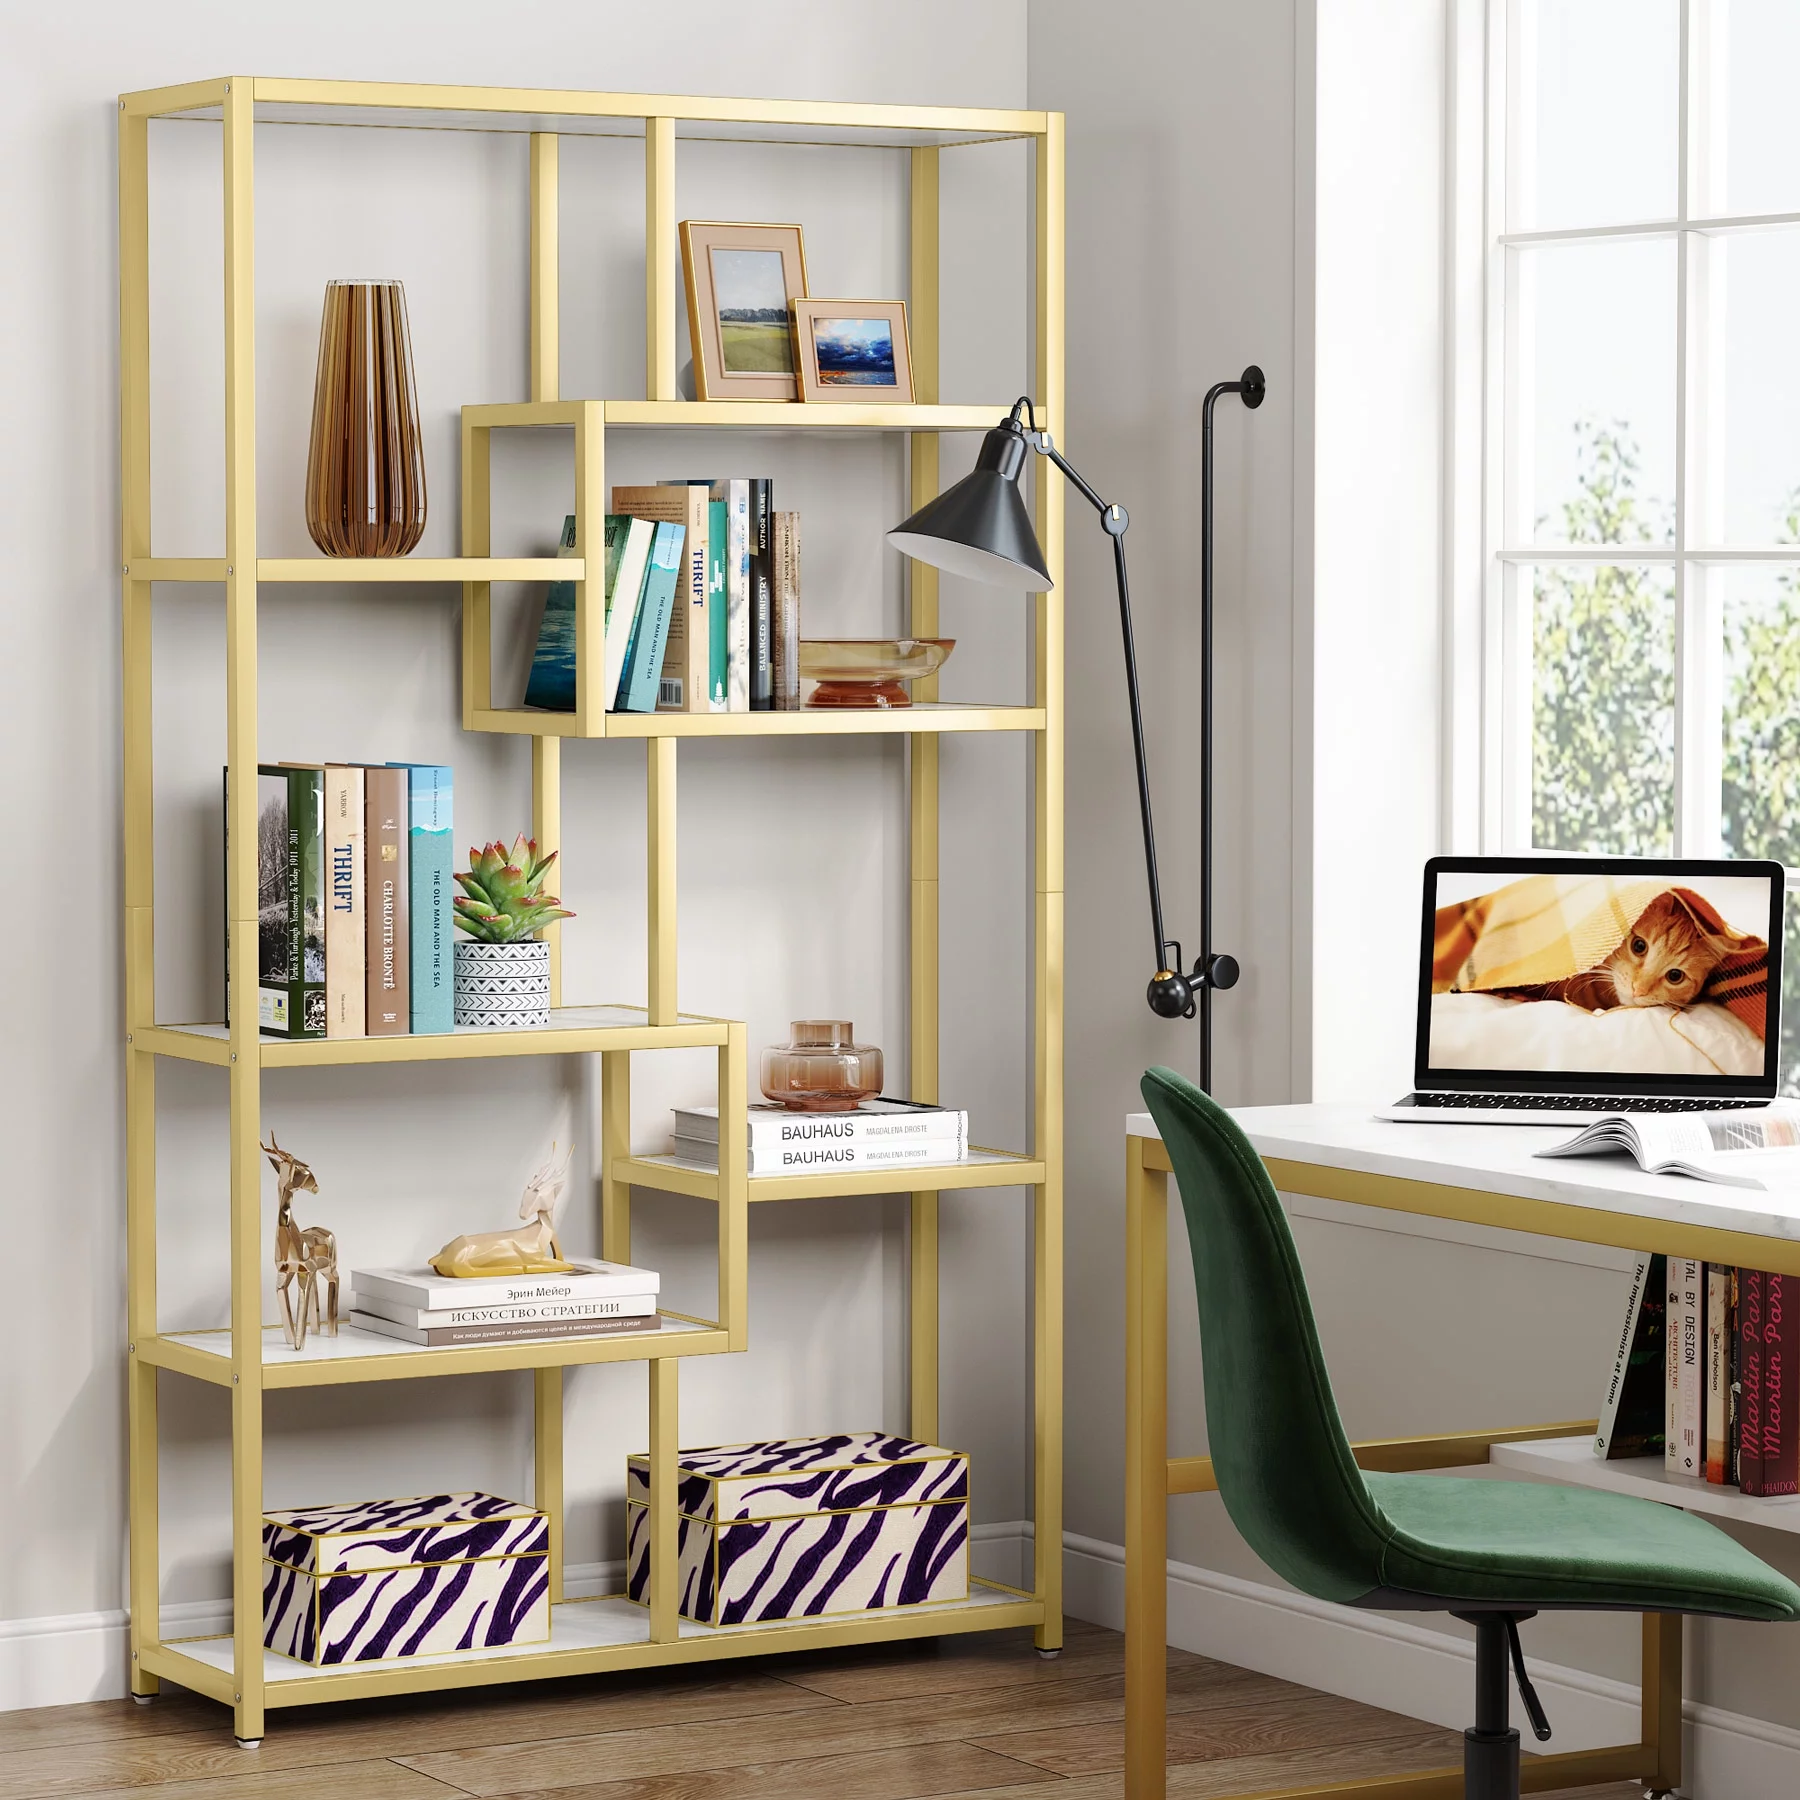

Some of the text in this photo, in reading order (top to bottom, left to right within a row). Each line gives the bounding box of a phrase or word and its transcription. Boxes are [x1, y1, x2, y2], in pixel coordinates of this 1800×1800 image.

[693, 549, 704, 608] THRIFT
[759, 624, 767, 671] BALANCED
[289, 829, 299, 845] 2011
[289, 851, 299, 866] 1911
[289, 868, 301, 886] Today
[334, 844, 353, 913] THRIFT
[289, 893, 301, 922] Yesterday
[289, 927, 301, 956] Turlough
[383, 880, 396, 990] CHARLOTTE BRONTË
[289, 962, 299, 981] Parke
[782, 1122, 854, 1140] BAUHAUS
[866, 1124, 928, 1136] MAGDALENA DROSTE
[783, 1148, 854, 1165] BAUHAUS
[866, 1149, 928, 1160] MAGDALENA DROSTE
[507, 1286, 571, 1300] Эрин Мейер
[451, 1303, 620, 1322] ИСКУССТВО СТРАТЕГИИ
[1685, 1261, 1695, 1365] TAL BY DESIGN
[1742, 1272, 1760, 1343] Parr
[1764, 1274, 1782, 1344] Parr
[512, 1327, 548, 1336] добиваются
[574, 1321, 622, 1331] международной
[623, 1320, 641, 1328] среде
[1607, 1264, 1644, 1405] The Impressionists at Home
[1741, 1352, 1760, 1454] Martin
[1763, 1352, 1782, 1454] Martin
[1761, 1481, 1797, 1493] PHAIDON
